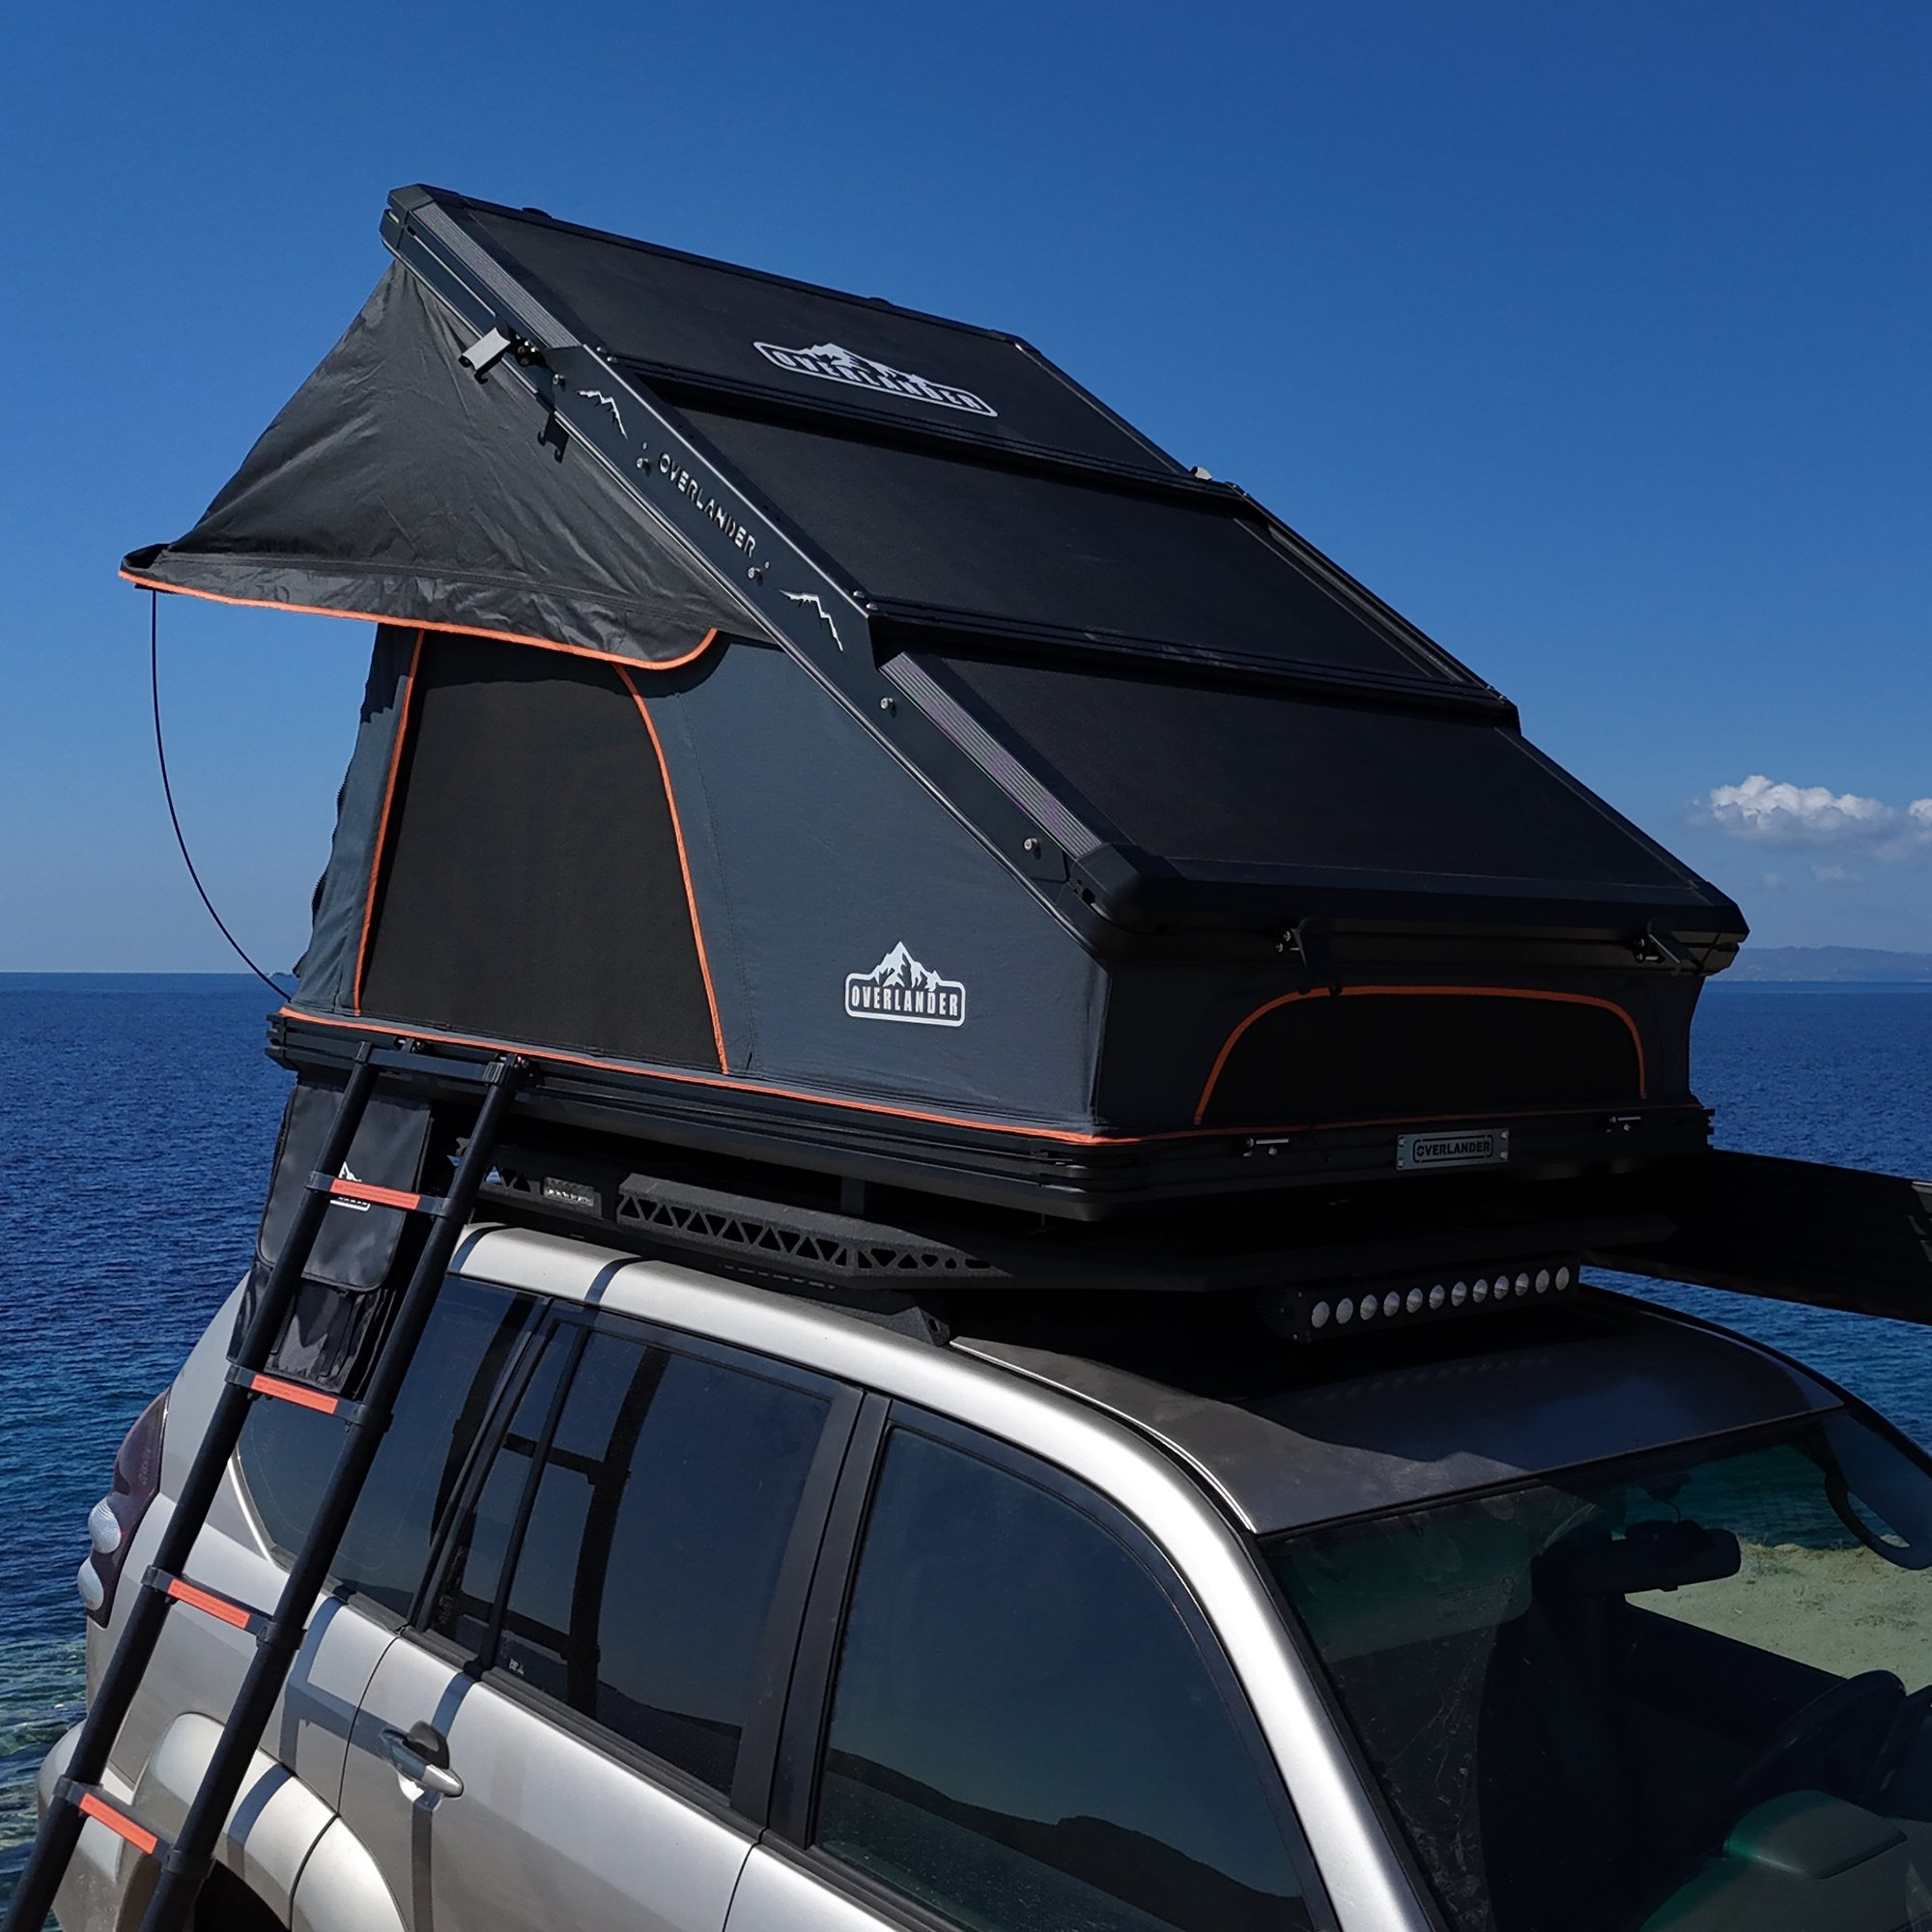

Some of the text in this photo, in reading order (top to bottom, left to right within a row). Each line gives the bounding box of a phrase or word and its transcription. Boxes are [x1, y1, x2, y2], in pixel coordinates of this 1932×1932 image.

[772, 350, 983, 411] OVERLANDER
[658, 453, 756, 557] OVERLANDER
[851, 984, 958, 1016] OVERLANDER
[1416, 1141, 1491, 1157] OVERLANDER
